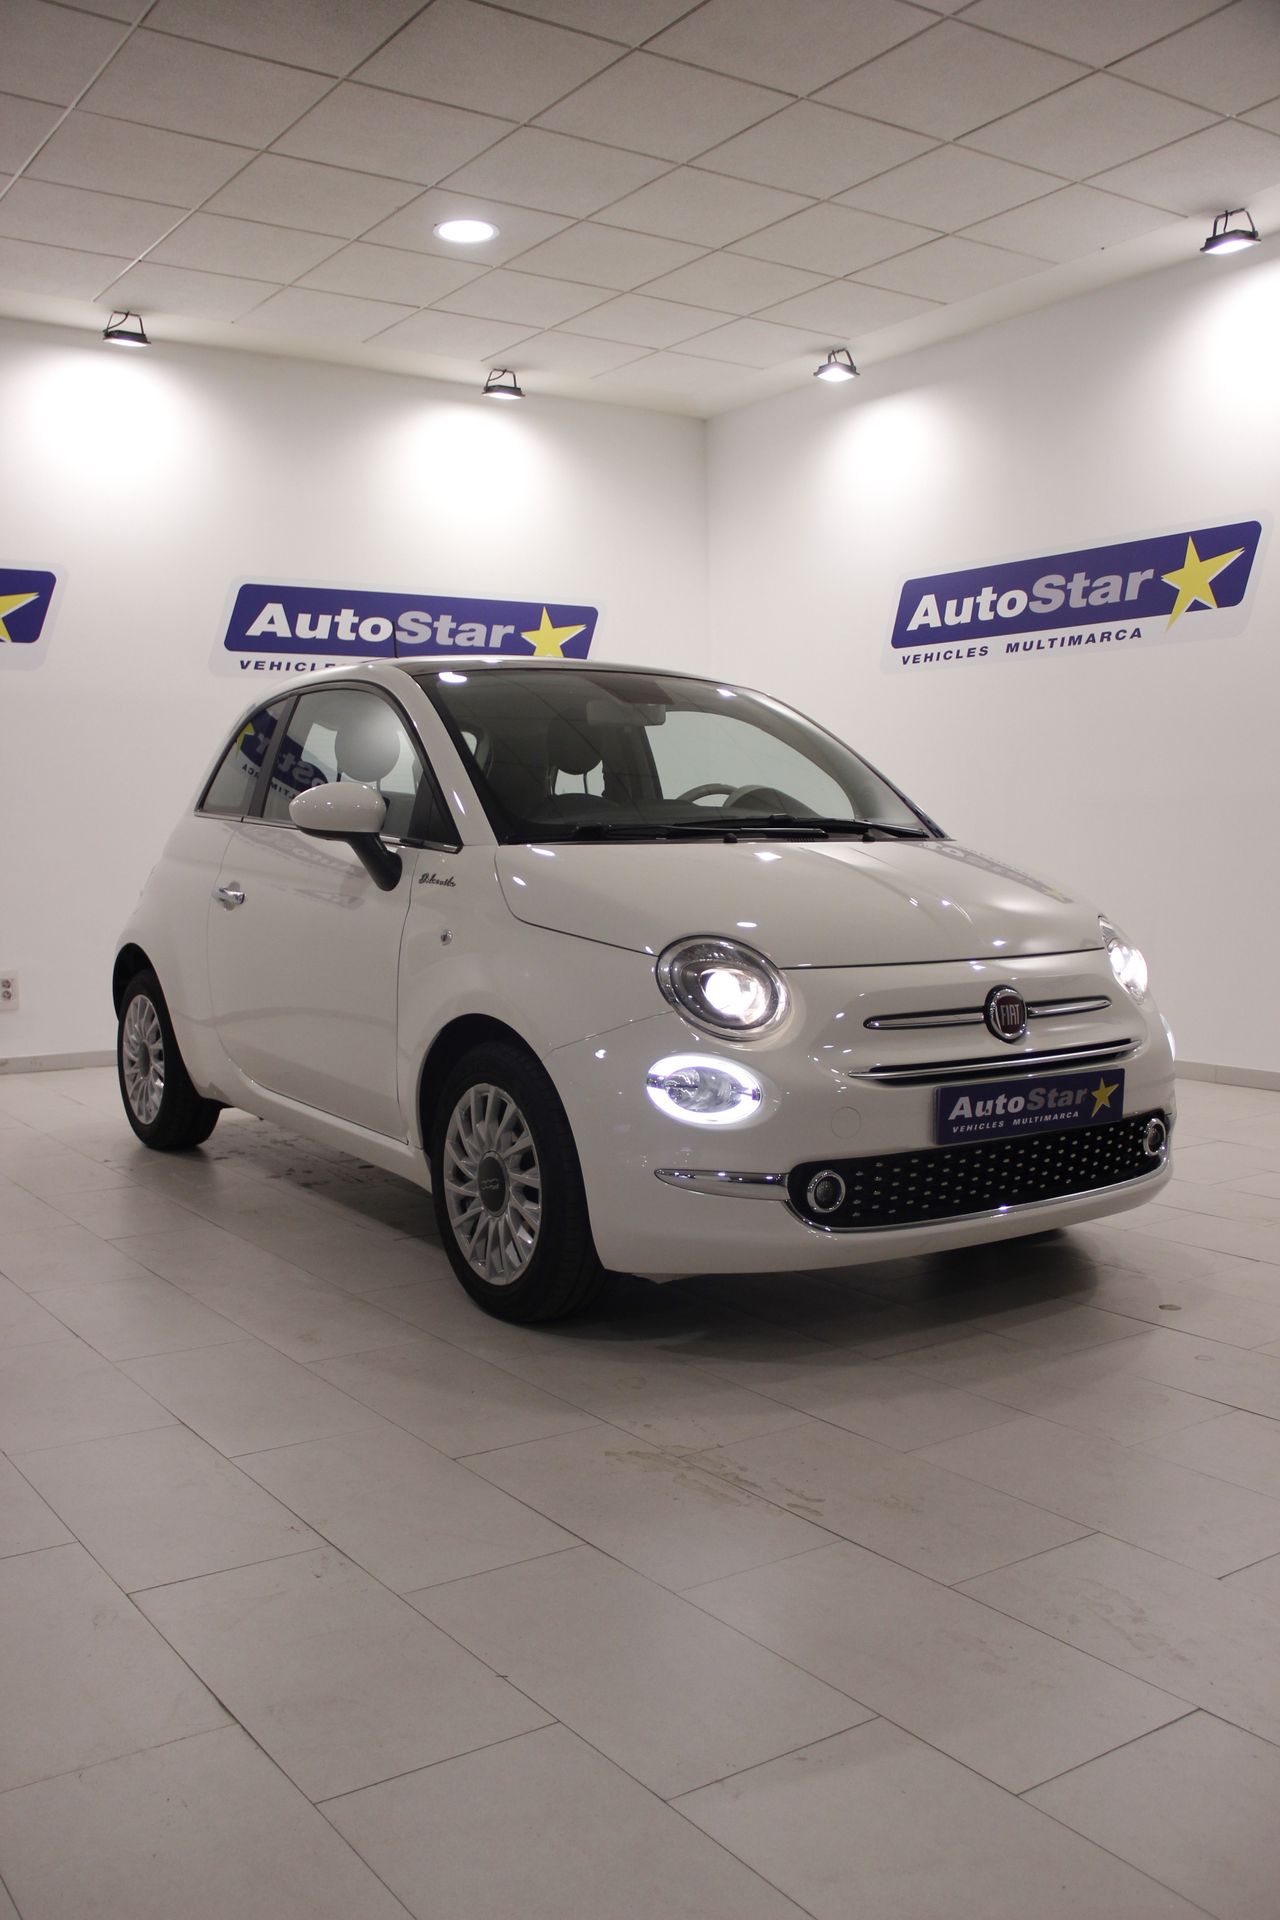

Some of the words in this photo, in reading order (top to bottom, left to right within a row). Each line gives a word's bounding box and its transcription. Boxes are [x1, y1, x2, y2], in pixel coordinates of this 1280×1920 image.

[906, 568, 1154, 632] AutoStar
[245, 602, 515, 648] AutoStar
[901, 645, 989, 666] VEHICLES
[1005, 627, 1142, 654] MULTIMARCA
[240, 660, 340, 672] VEHICL
[1000, 1004, 1019, 1025] FIAT
[948, 1088, 1087, 1120] AutoStar
[952, 1120, 1004, 1133] VEHICLES
[1012, 1111, 1079, 1126] MULTIMARCA
